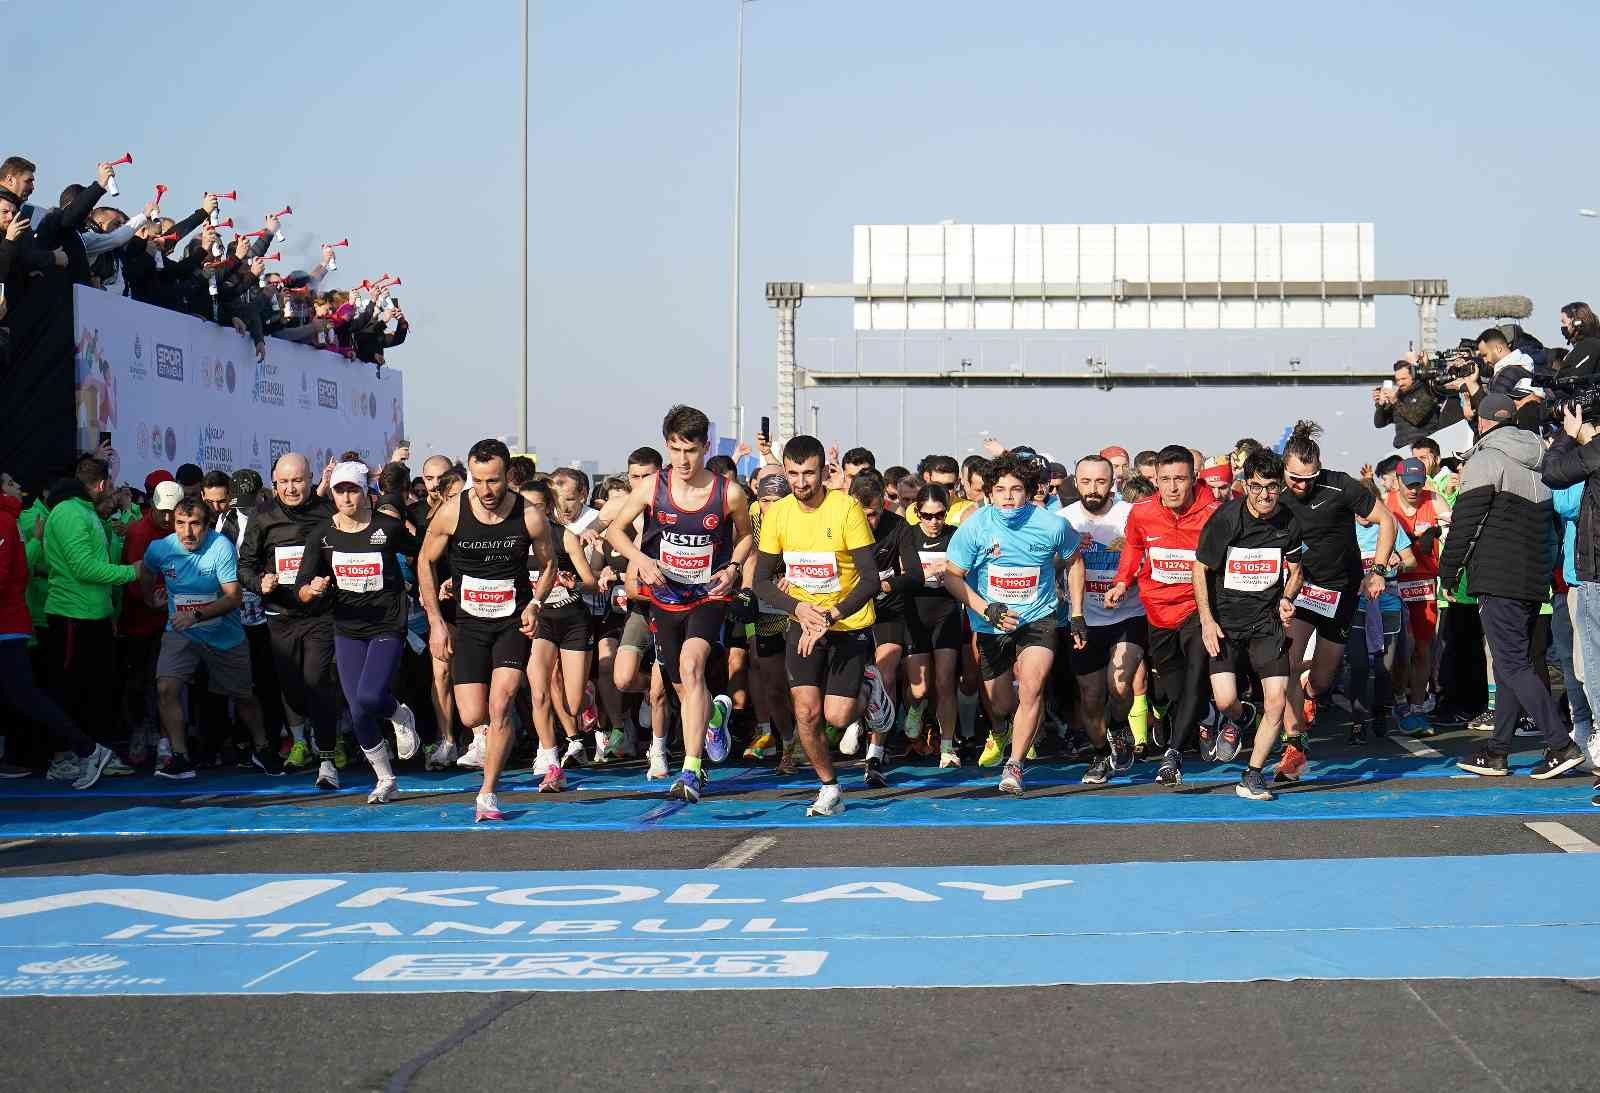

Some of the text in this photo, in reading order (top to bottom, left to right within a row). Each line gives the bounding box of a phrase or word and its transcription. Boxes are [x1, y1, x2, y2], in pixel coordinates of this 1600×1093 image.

[457, 539, 516, 549] ACADEMY OF
[675, 558, 705, 567] 10678
[1164, 562, 1190, 570] 12742
[1243, 562, 1272, 571] 10523
[347, 566, 375, 575] 10562
[336, 880, 1075, 908] KOLAY
[101, 917, 809, 940] ISTANBUL
[411, 952, 786, 968] SPOR
